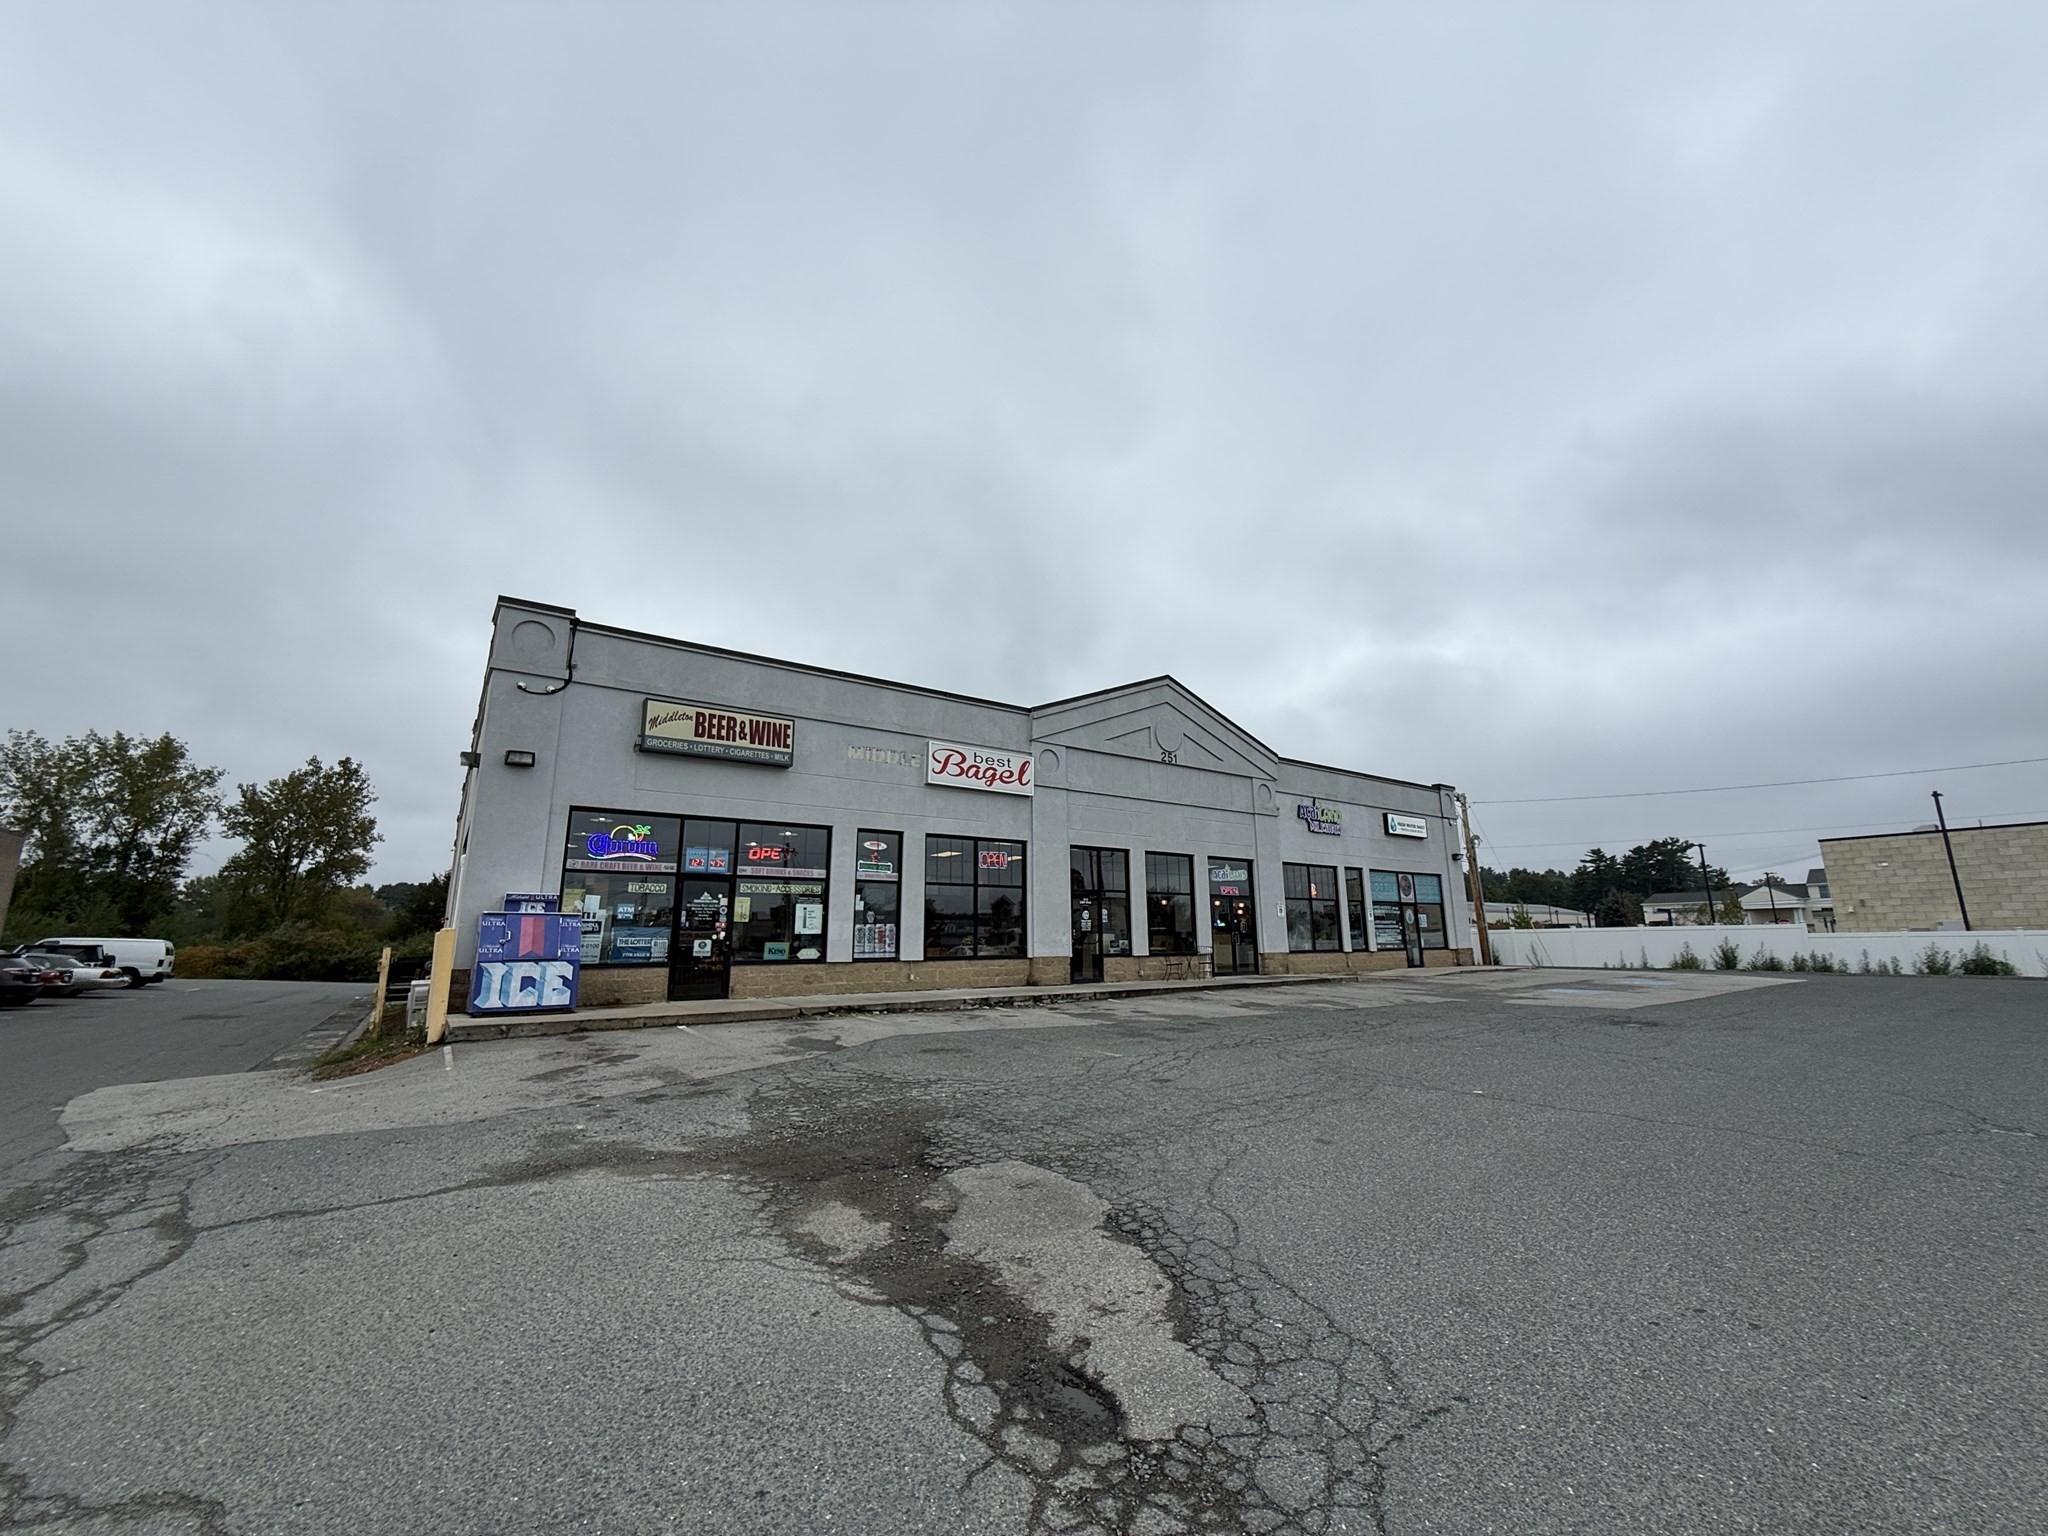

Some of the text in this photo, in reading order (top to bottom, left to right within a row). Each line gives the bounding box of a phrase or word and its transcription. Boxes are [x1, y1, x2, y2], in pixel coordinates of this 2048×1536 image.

[648, 711, 694, 731] Middleton
[694, 711, 737, 742] BEER
[749, 718, 791, 749] WINE
[646, 738, 689, 750] GROCERIES
[694, 744, 725, 754] LOTTERY
[729, 748, 770, 760] CIGARETTES
[973, 752, 1012, 768] best
[1160, 751, 1178, 764] 251
[931, 748, 1031, 788] Bagel
[586, 833, 659, 856] Corona
[599, 861, 621, 870] CRAFT
[621, 862, 638, 871] BEER
[980, 852, 1006, 867] OPEN
[629, 883, 666, 893] TOBACCO
[1221, 887, 1239, 895] OPEN
[518, 902, 546, 912] ICE
[479, 946, 503, 954] ULTRA
[473, 961, 574, 1009] ICE
